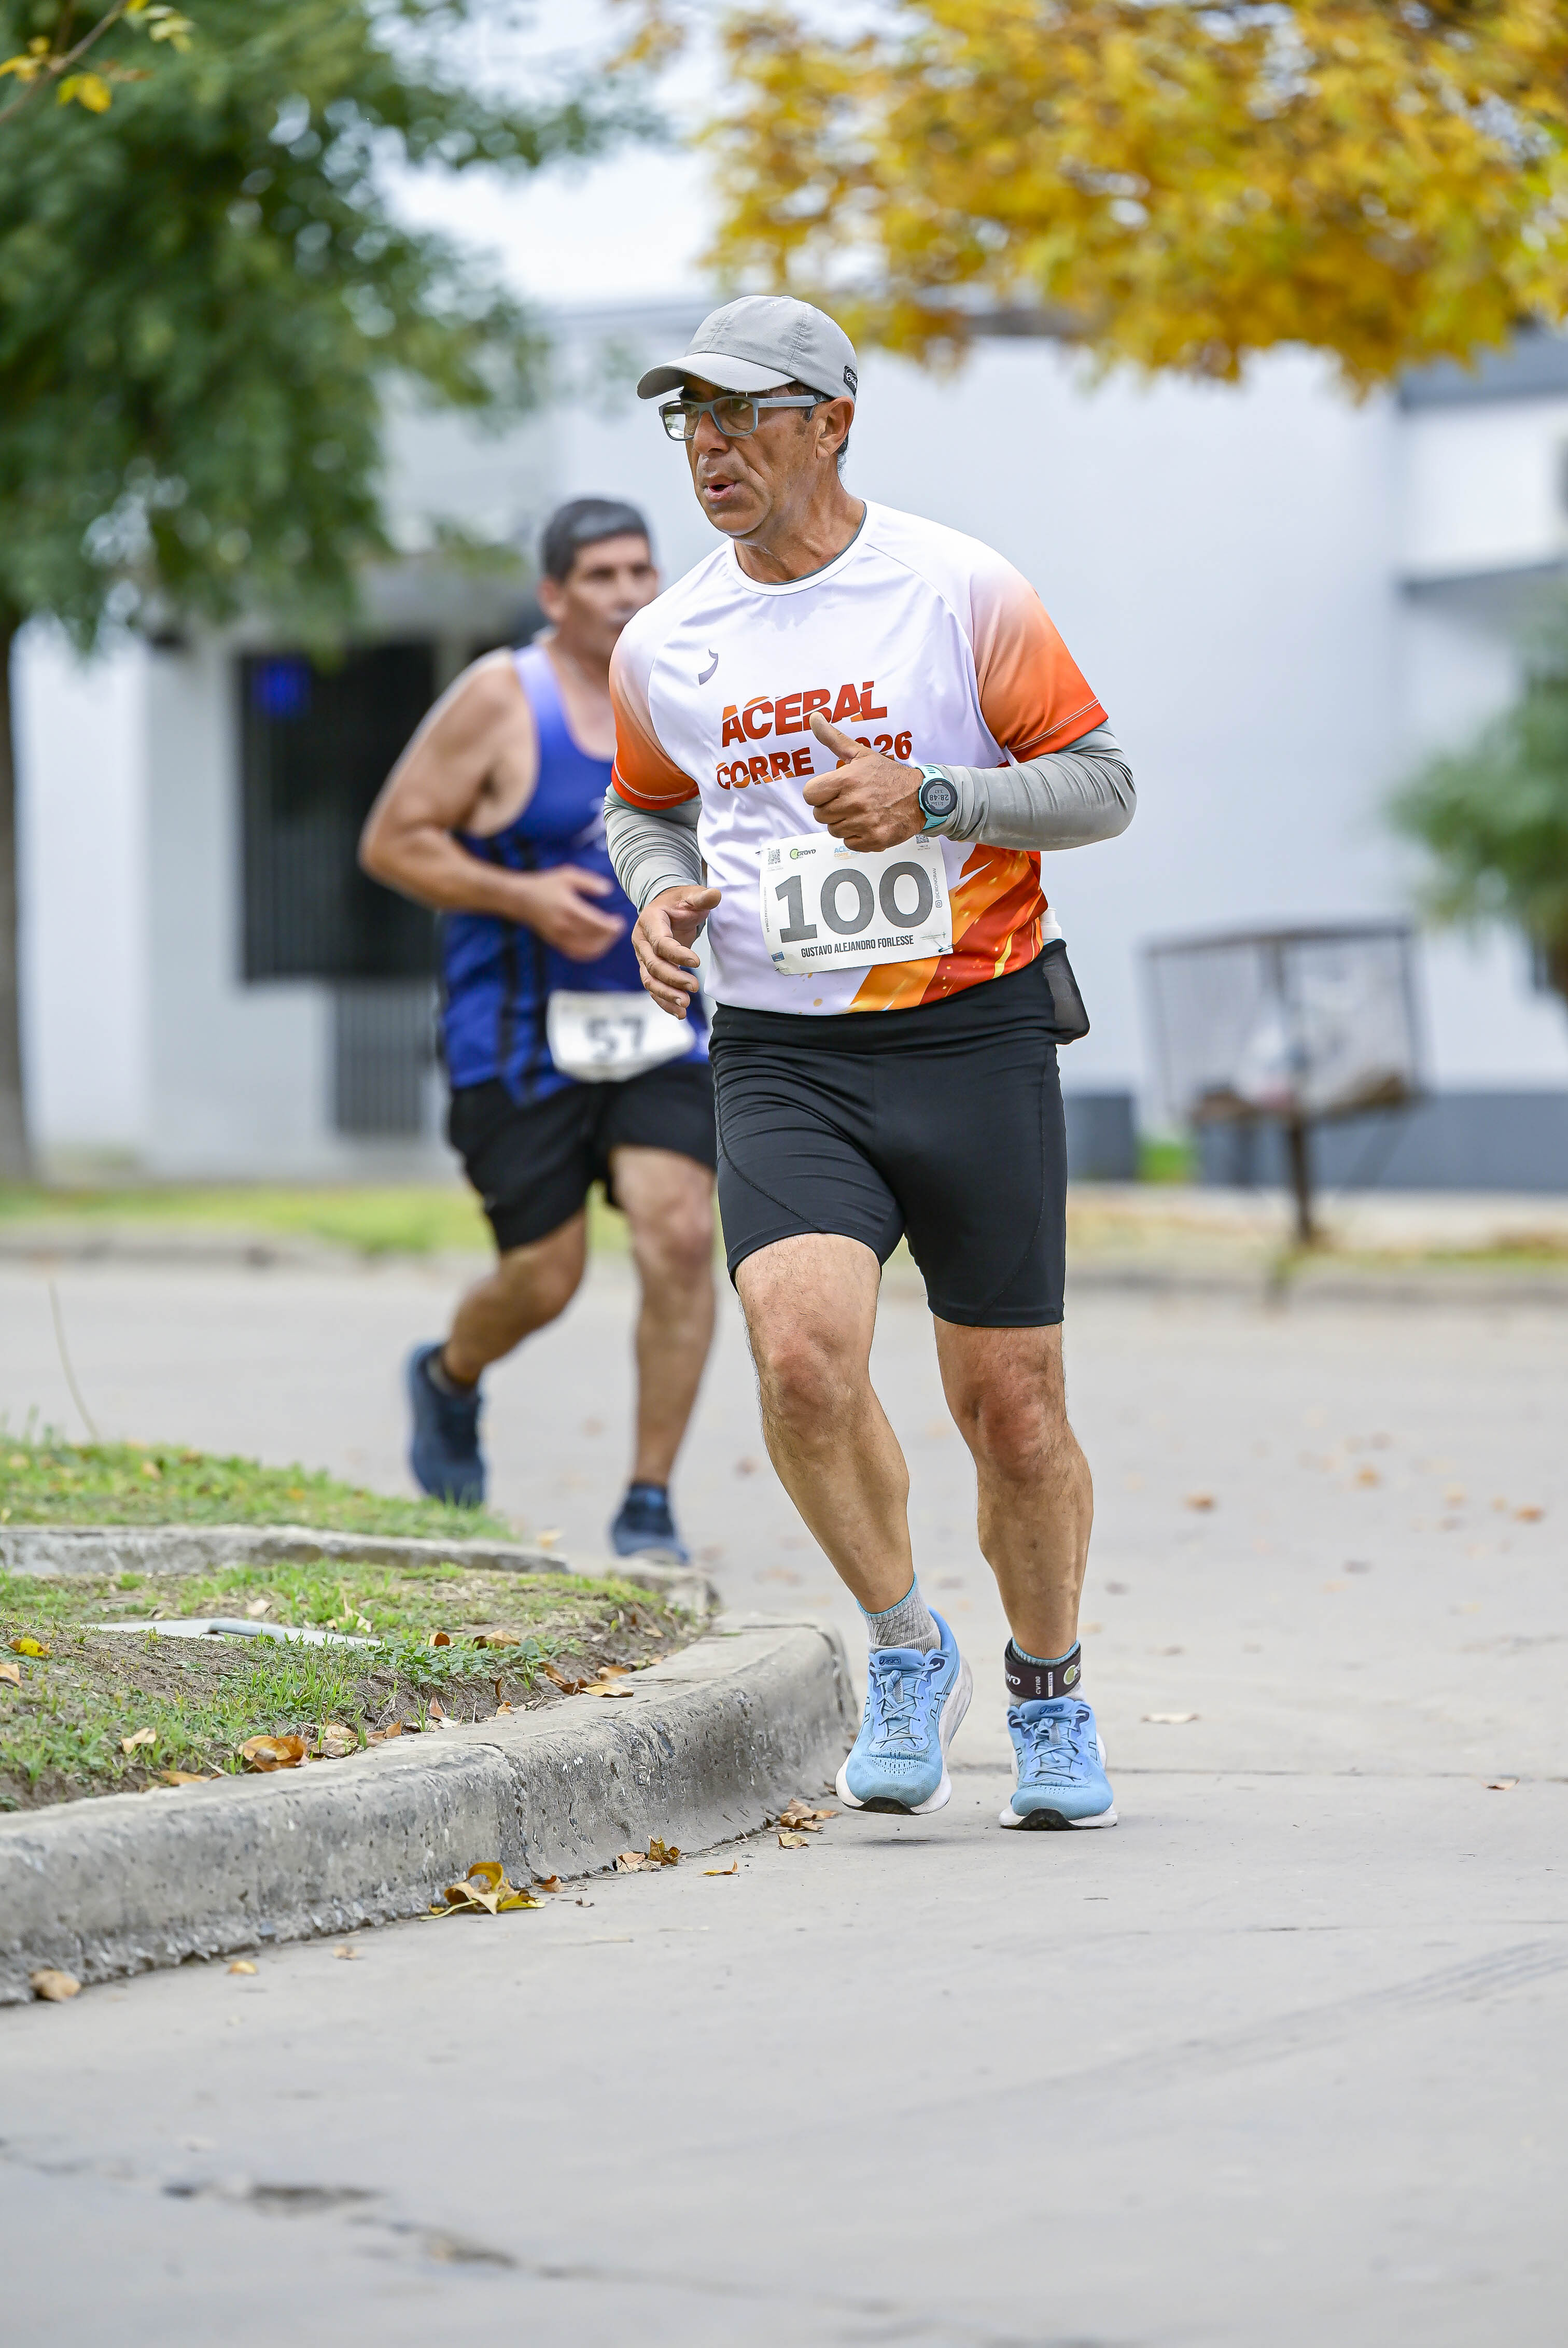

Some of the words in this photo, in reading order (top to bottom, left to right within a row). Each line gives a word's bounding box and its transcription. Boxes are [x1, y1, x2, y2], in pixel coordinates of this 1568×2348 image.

[722, 681, 887, 748] ACEBAL
[716, 747, 815, 790] CORRE
[836, 730, 913, 769] 26
[775, 861, 933, 943] 100
[801, 944, 832, 958] GUSTAVO
[834, 939, 876, 953] ALEJANDRO
[877, 934, 914, 948] FORLESSE
[585, 1017, 647, 1064] 57
